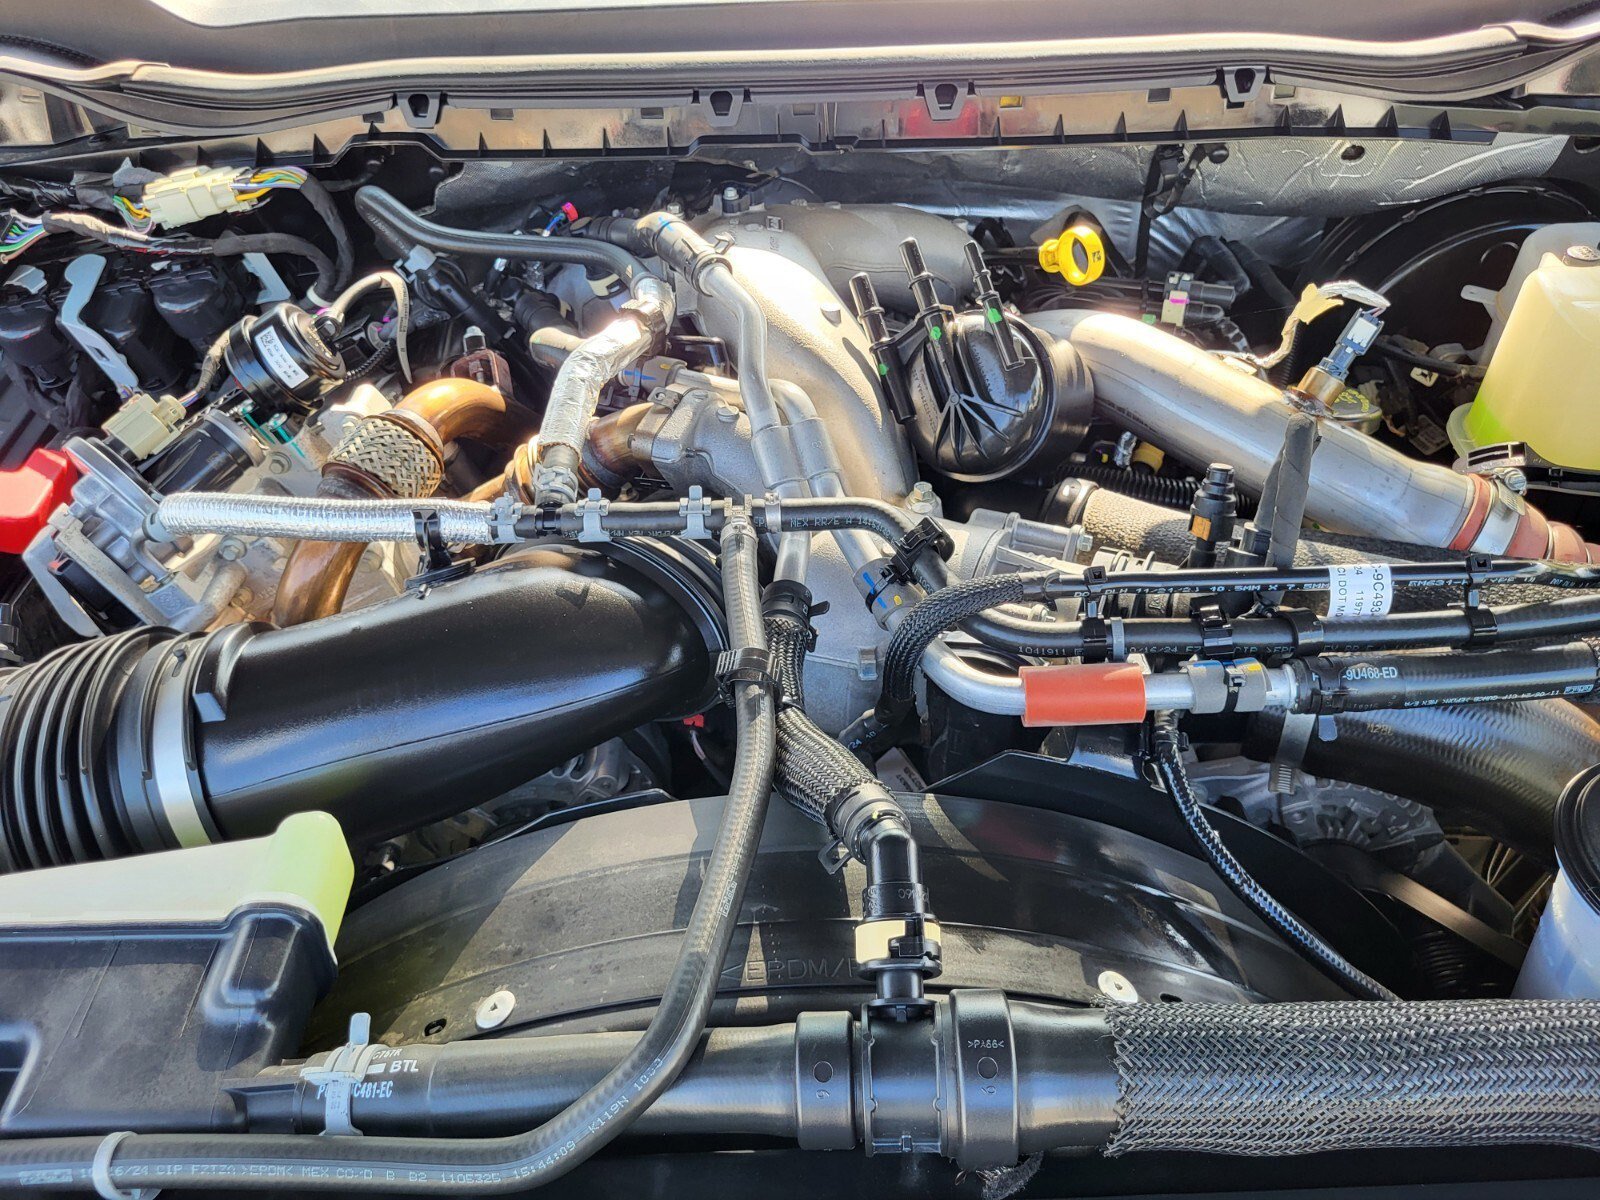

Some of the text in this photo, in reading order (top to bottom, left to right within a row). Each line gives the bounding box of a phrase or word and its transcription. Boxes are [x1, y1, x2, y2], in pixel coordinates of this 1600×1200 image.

[1018, 646, 1066, 656] 1041911
[389, 1059, 419, 1073] BTL
[156, 1164, 183, 1176] CIP
[301, 1165, 330, 1178] MEX
[440, 1172, 502, 1184] 1105325
[513, 1139, 577, 1180] 15:44:09
[587, 1094, 630, 1134] K119N
